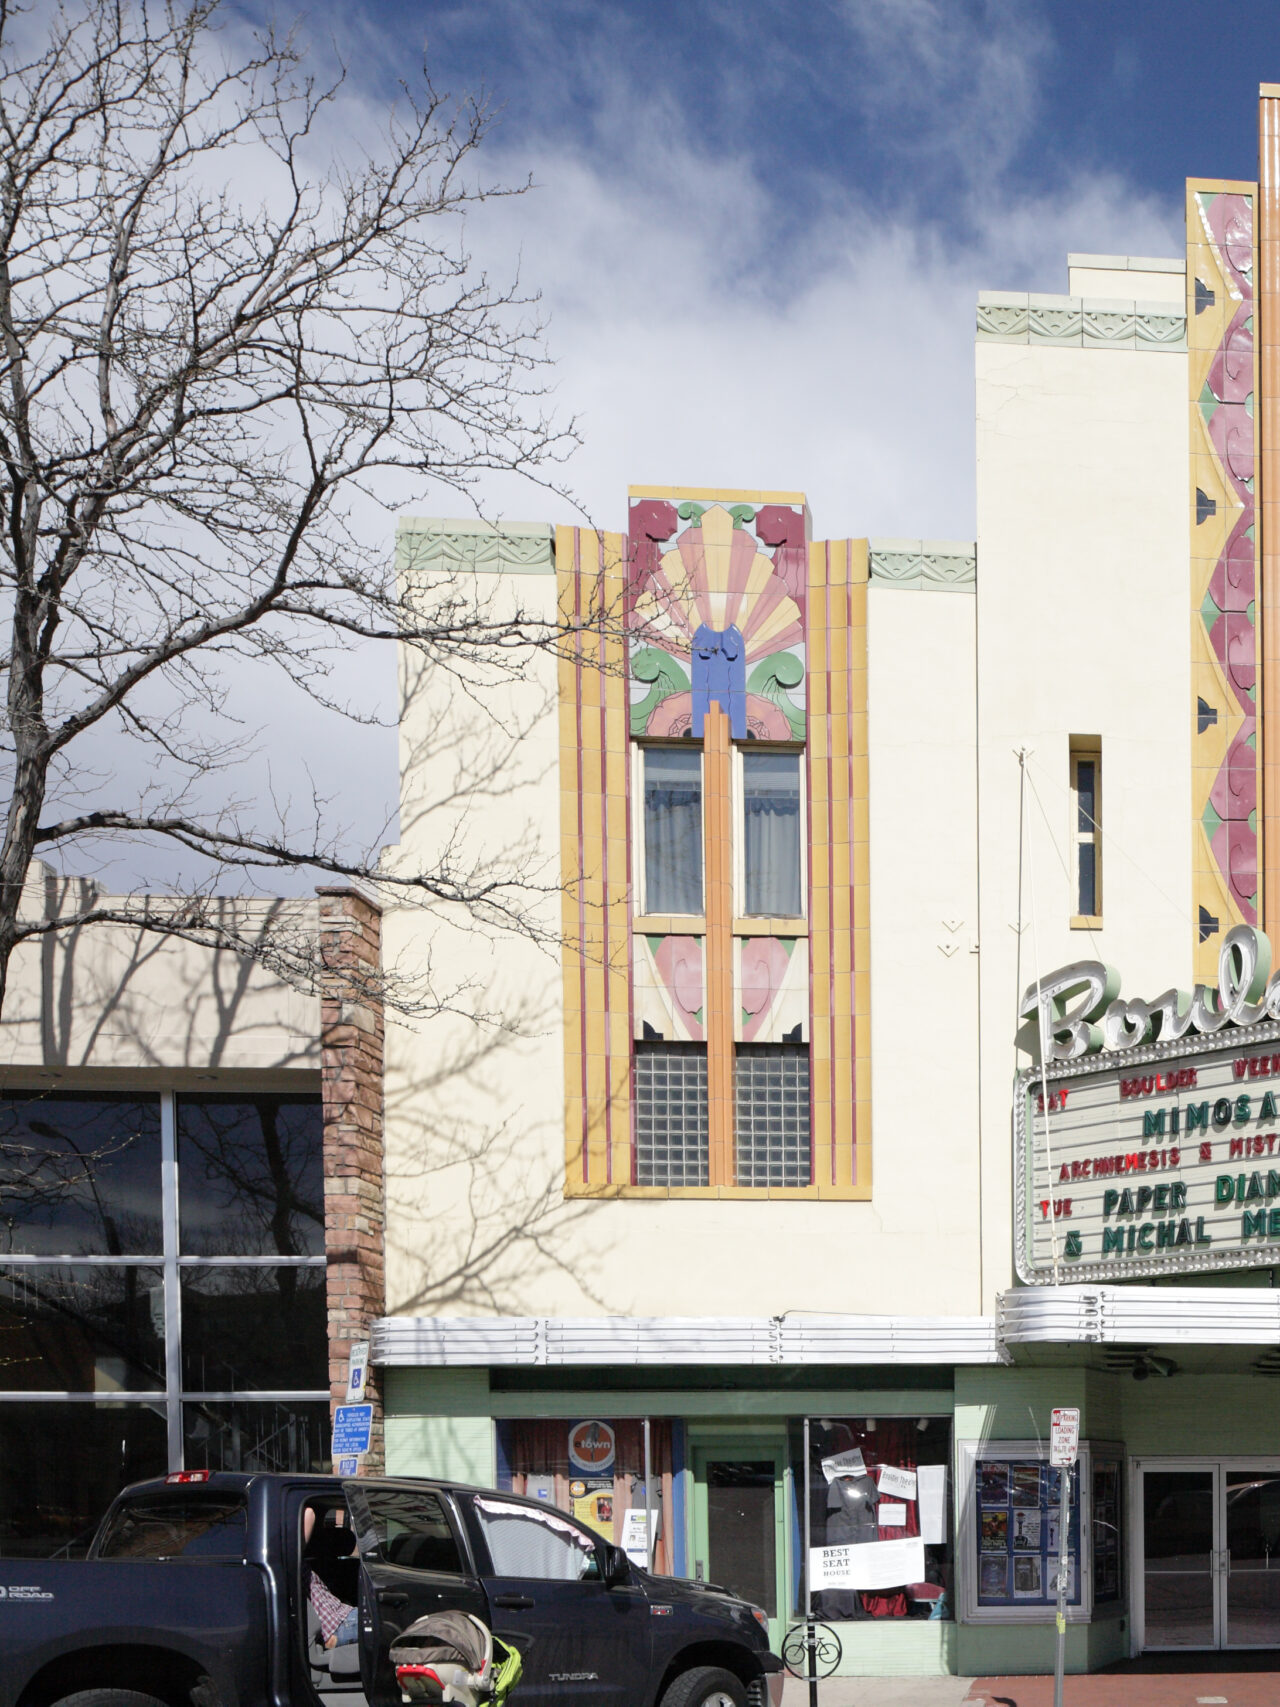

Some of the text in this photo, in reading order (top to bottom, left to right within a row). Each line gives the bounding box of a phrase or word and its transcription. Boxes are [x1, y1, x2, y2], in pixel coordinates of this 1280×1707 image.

[1120, 1067, 1198, 1097] BOULDER
[1038, 1089, 1069, 1113] SAT
[1143, 1091, 1278, 1137] MIMOSA
[1199, 1141, 1212, 1162] &
[1039, 1198, 1073, 1218] TUE
[1103, 1181, 1187, 1217] PAPER
[1064, 1230, 1082, 1257] &
[1102, 1215, 1212, 1254] MICHAL
[1055, 1426, 1074, 1434] LOADING
[1058, 1436, 1071, 1444] ZONE
[823, 1548, 850, 1558] BEST
[823, 1559, 850, 1568] SEAT
[823, 1569, 851, 1577] HOUSE
[549, 1672, 599, 1681] TUNDRA
